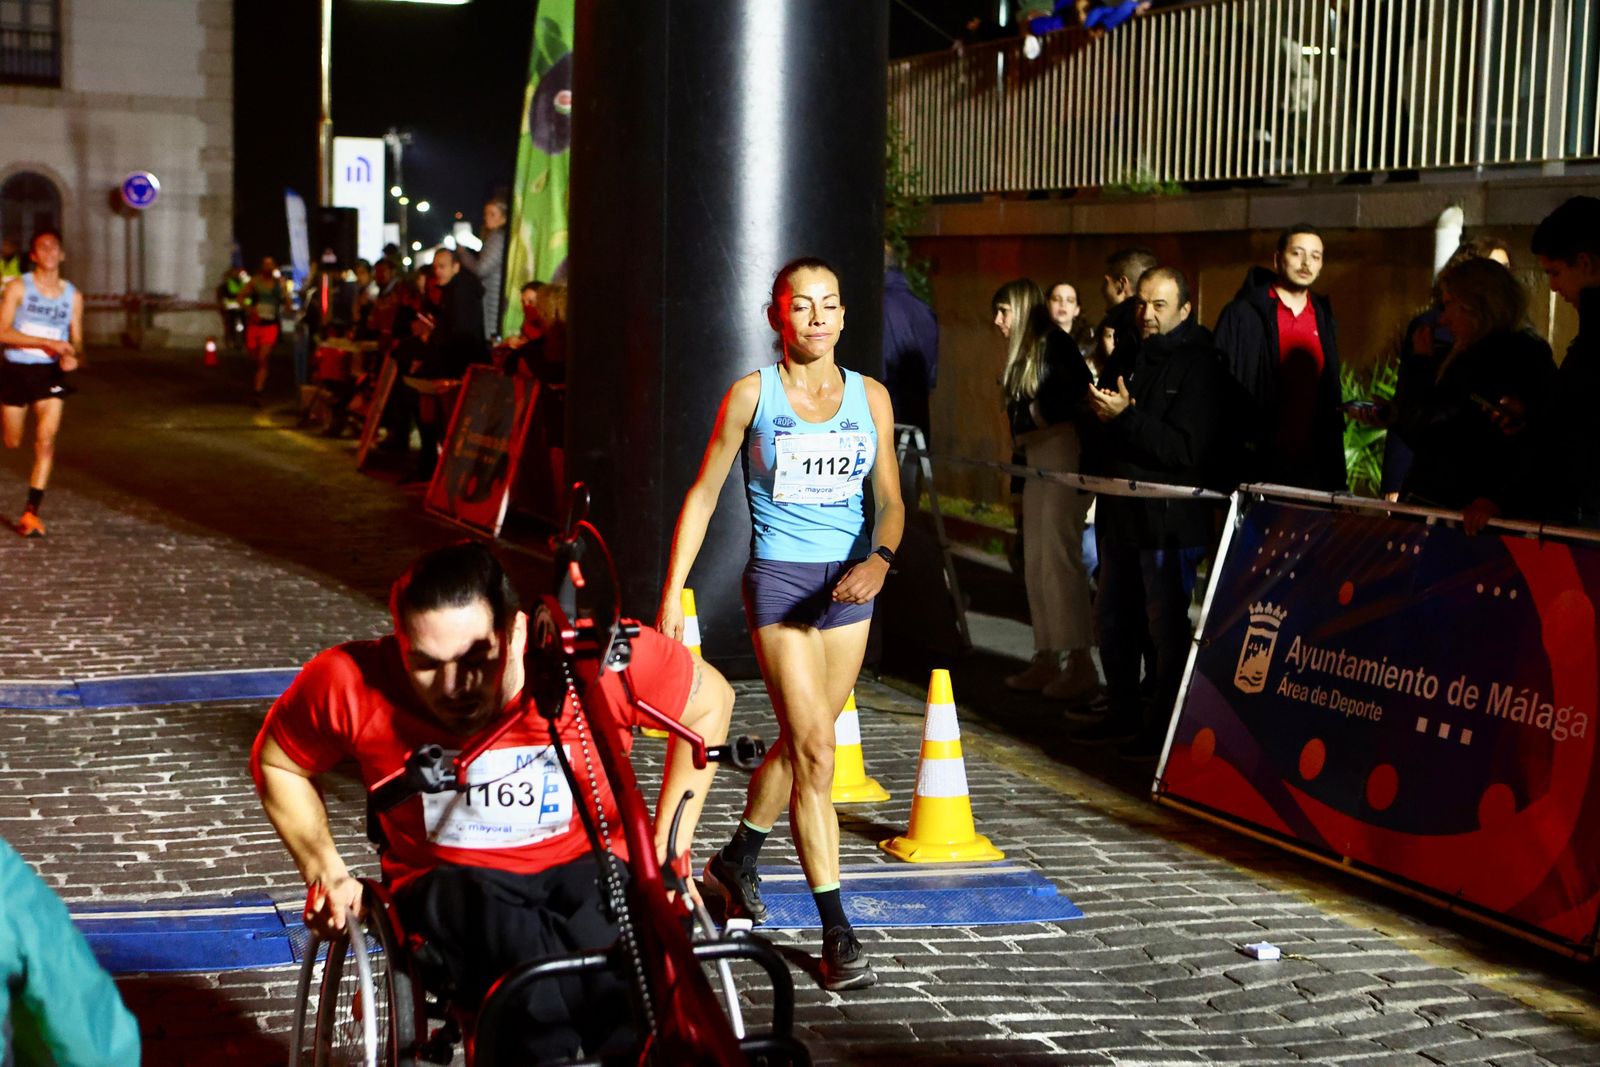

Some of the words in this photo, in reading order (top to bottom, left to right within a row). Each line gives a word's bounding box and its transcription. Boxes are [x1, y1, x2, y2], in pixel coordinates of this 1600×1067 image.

[802, 457, 850, 475] 1112
[1277, 671, 1309, 702] Área
[1311, 687, 1327, 708] de
[1329, 688, 1383, 723] Deporte
[1284, 634, 1439, 700] Ayuntamiento
[1447, 675, 1480, 710] de
[1485, 682, 1589, 742] Málaga
[466, 783, 534, 806] 1163
[468, 823, 512, 834] mayoral
